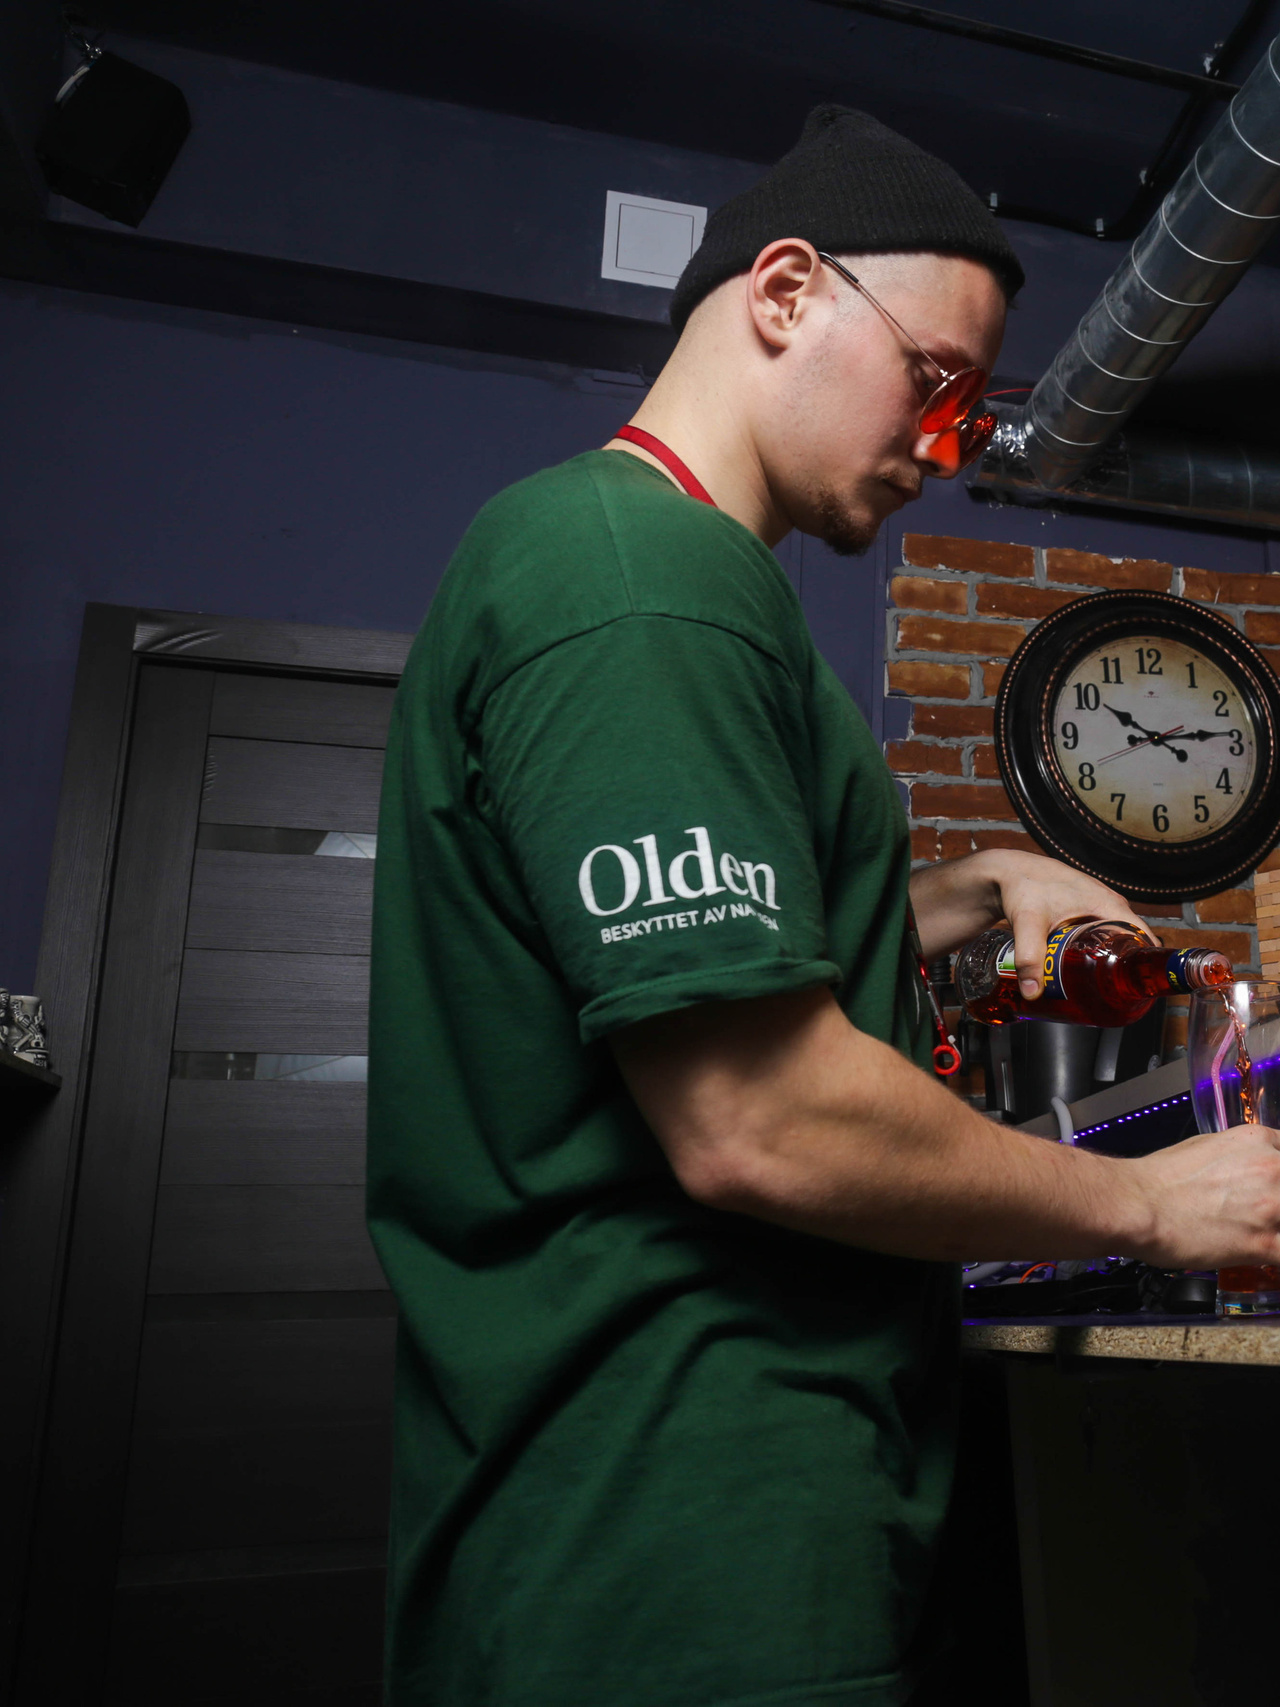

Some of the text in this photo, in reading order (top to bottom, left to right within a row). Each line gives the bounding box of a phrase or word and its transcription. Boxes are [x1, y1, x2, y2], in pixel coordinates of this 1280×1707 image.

[1100, 657, 1124, 684] 11
[1135, 647, 1163, 675] 12
[1185, 661, 1198, 688] 1
[1073, 682, 1100, 711] 10
[1213, 690, 1229, 717] 2
[1061, 721, 1079, 749] 9
[1229, 729, 1244, 756] 3
[1078, 762, 1096, 790] 8
[1215, 767, 1233, 794] 4
[1110, 793, 1126, 821] 7
[1152, 804, 1170, 832] 6
[1194, 795, 1209, 822] 5
[578, 826, 781, 917] Olden
[601, 910, 698, 944] BESKYTTET
[703, 904, 727, 925] AV
[1044, 924, 1080, 987] PEROL
